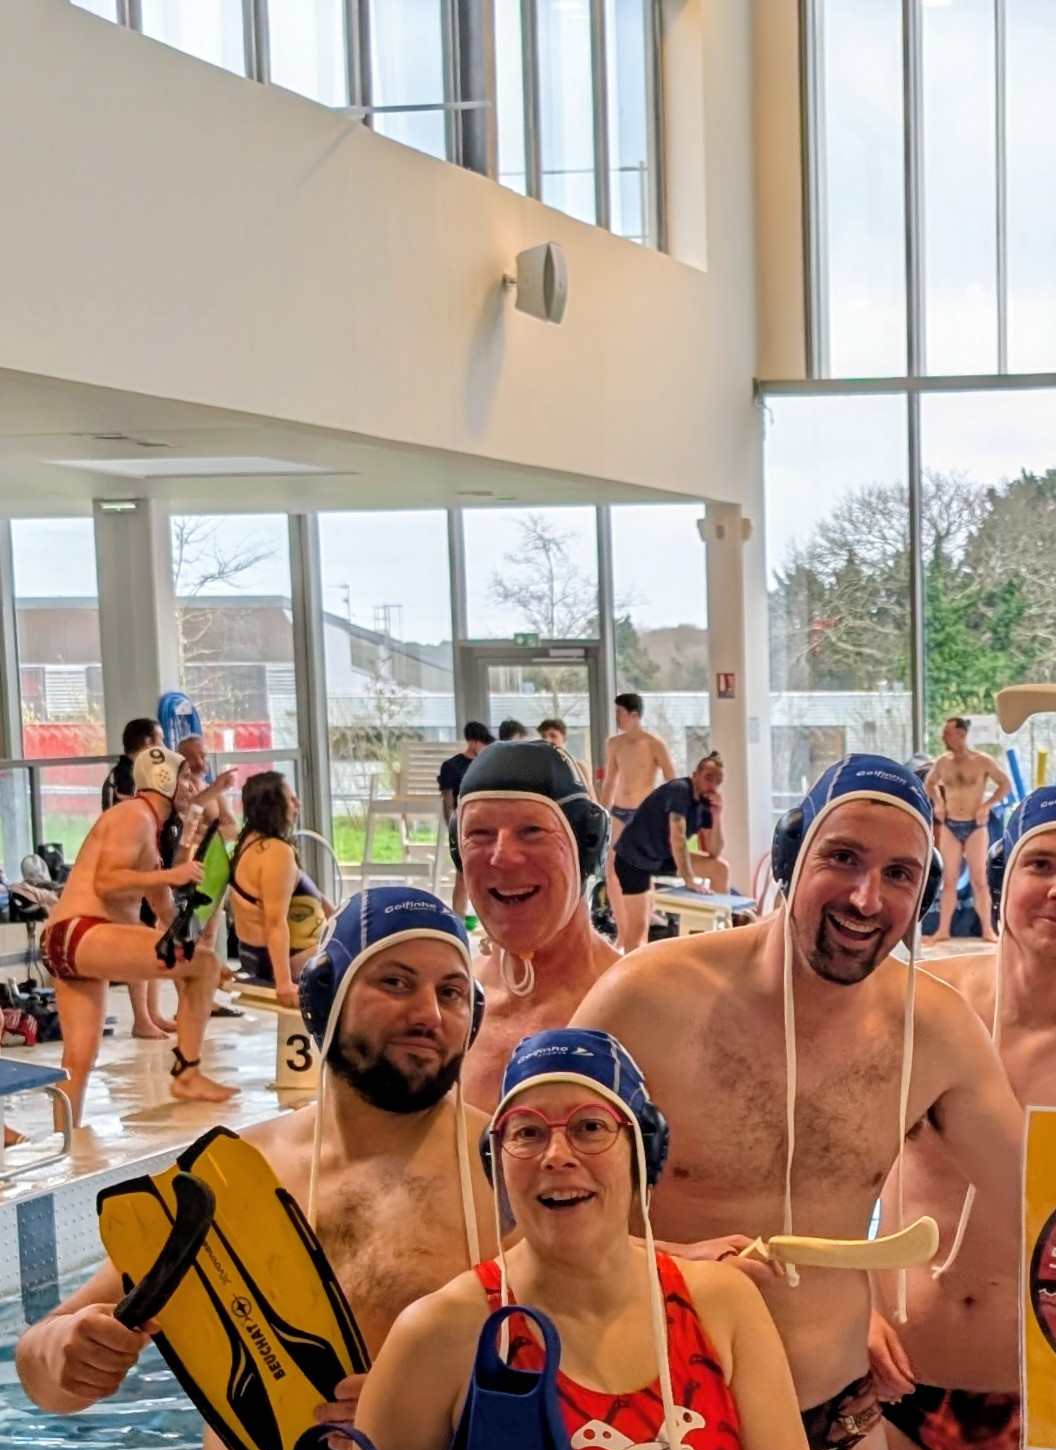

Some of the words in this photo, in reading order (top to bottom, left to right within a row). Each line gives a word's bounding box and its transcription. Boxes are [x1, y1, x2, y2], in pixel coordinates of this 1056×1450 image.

[149, 748, 166, 765] 9
[286, 1034, 313, 1073] 3
[246, 1323, 286, 1381] BEUCHAT
